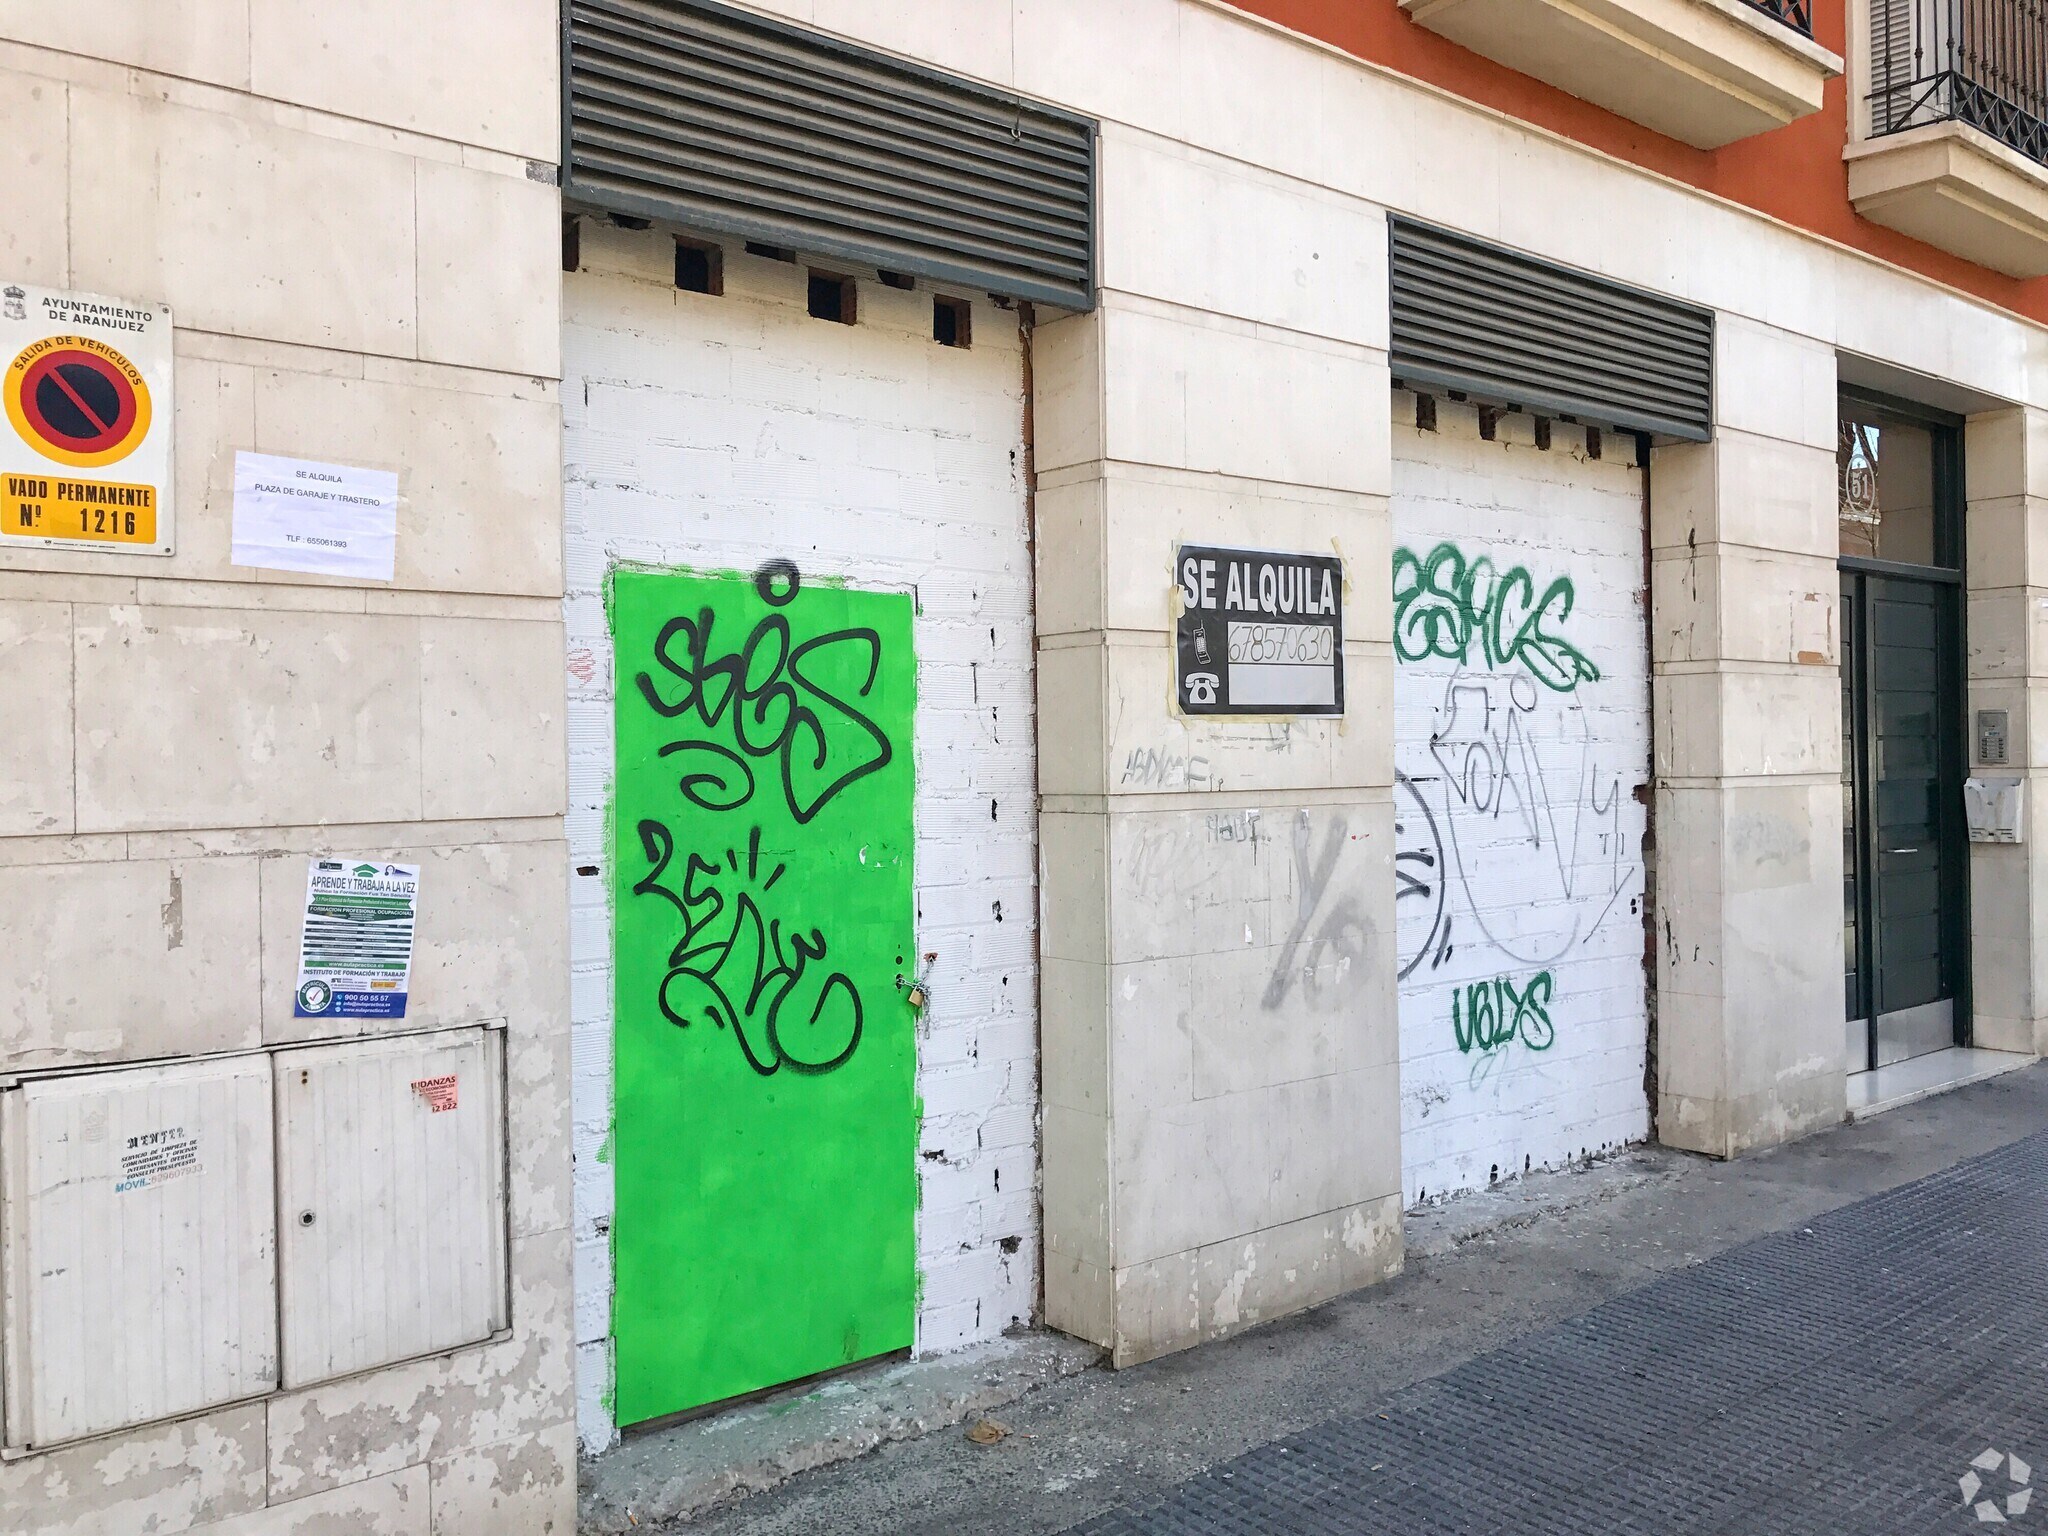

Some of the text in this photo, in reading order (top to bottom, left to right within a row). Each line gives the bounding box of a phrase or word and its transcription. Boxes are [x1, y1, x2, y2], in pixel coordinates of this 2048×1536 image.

[42, 297, 153, 322] AYUNTAMIENTO
[49, 310, 145, 333] DE ARANJUEZ
[14, 335, 142, 386] SALIDA DE VEHICULOS
[295, 470, 343, 484] SE ALQUILA
[1851, 471, 1870, 499] 51
[8, 477, 150, 508] VADO PERMANENTE
[254, 483, 381, 507] PLAZA DE GARAJE Y TRASTERO
[80, 507, 136, 536] 1216
[286, 534, 301, 544] TLF
[306, 536, 348, 549] 655061393
[1182, 557, 1336, 618] SE ALQUILA
[1228, 624, 1333, 662] 678570630
[311, 876, 416, 894] APRENDE Y TRABAJA A LA VEZ
[121, 1152, 148, 1163] SERVICIO
[161, 1142, 187, 1153] LIMPIEZA
[122, 1154, 164, 1169] COMUNIDADES
[172, 1145, 198, 1156] OFICINAS
[127, 1152, 195, 1174] INTERESANTES OFERTAS
[127, 1157, 197, 1180] CONSULTE PRESUPUESTO
